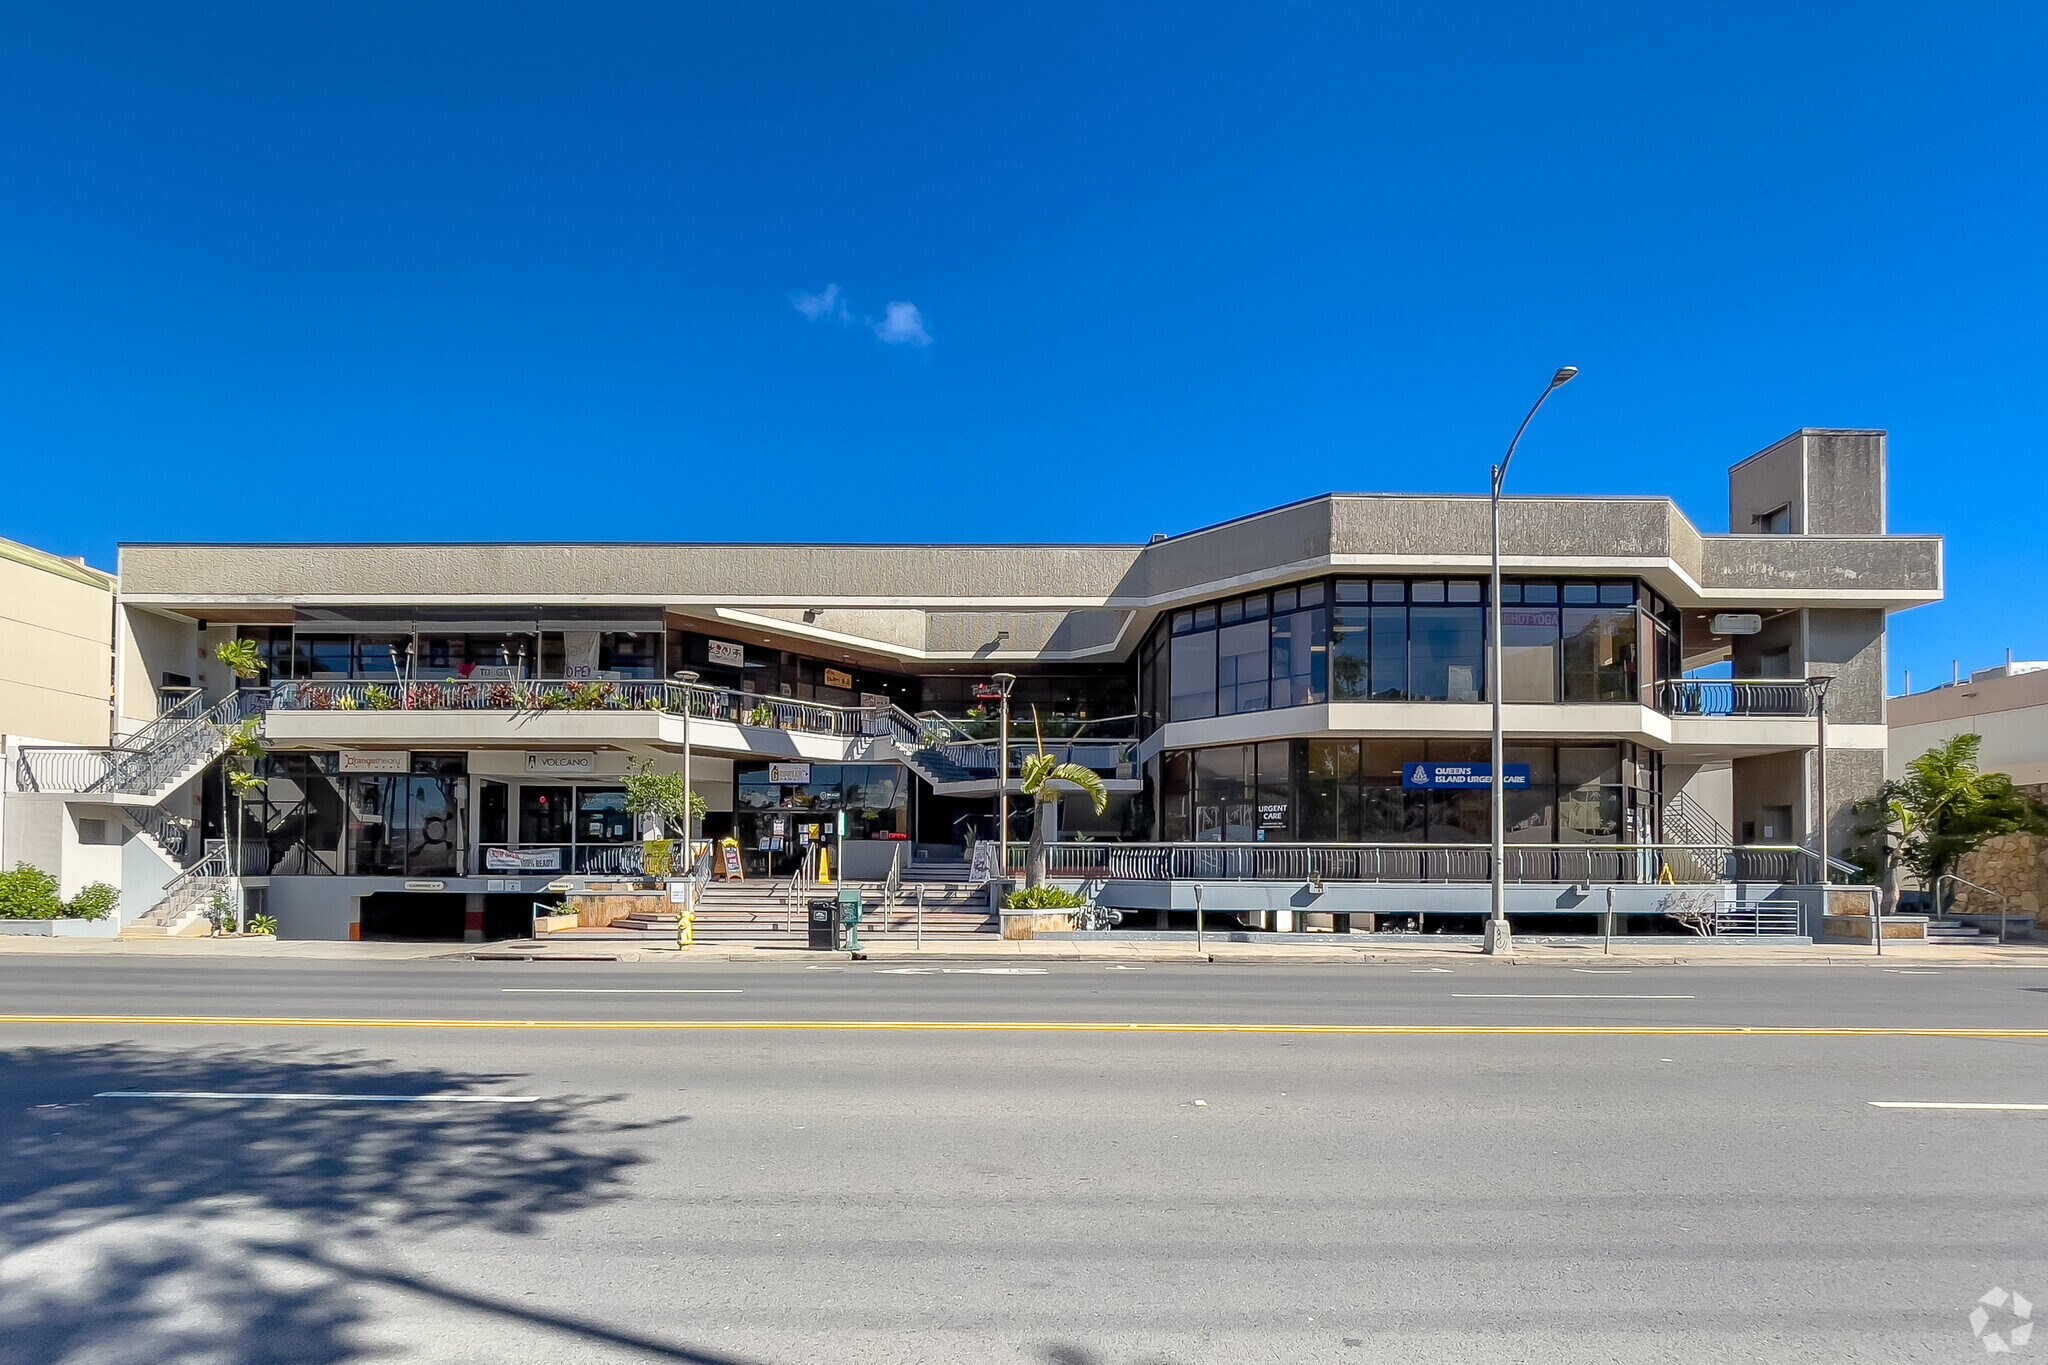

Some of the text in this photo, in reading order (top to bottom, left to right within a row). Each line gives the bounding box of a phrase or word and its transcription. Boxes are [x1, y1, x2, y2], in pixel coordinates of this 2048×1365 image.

[541, 758, 588, 766] VOLCANO
[1435, 767, 1472, 775] QUEEN'S
[1435, 775, 1466, 783] ISLAND
[1258, 804, 1288, 813] URGENT
[1263, 812, 1282, 820] CARE
